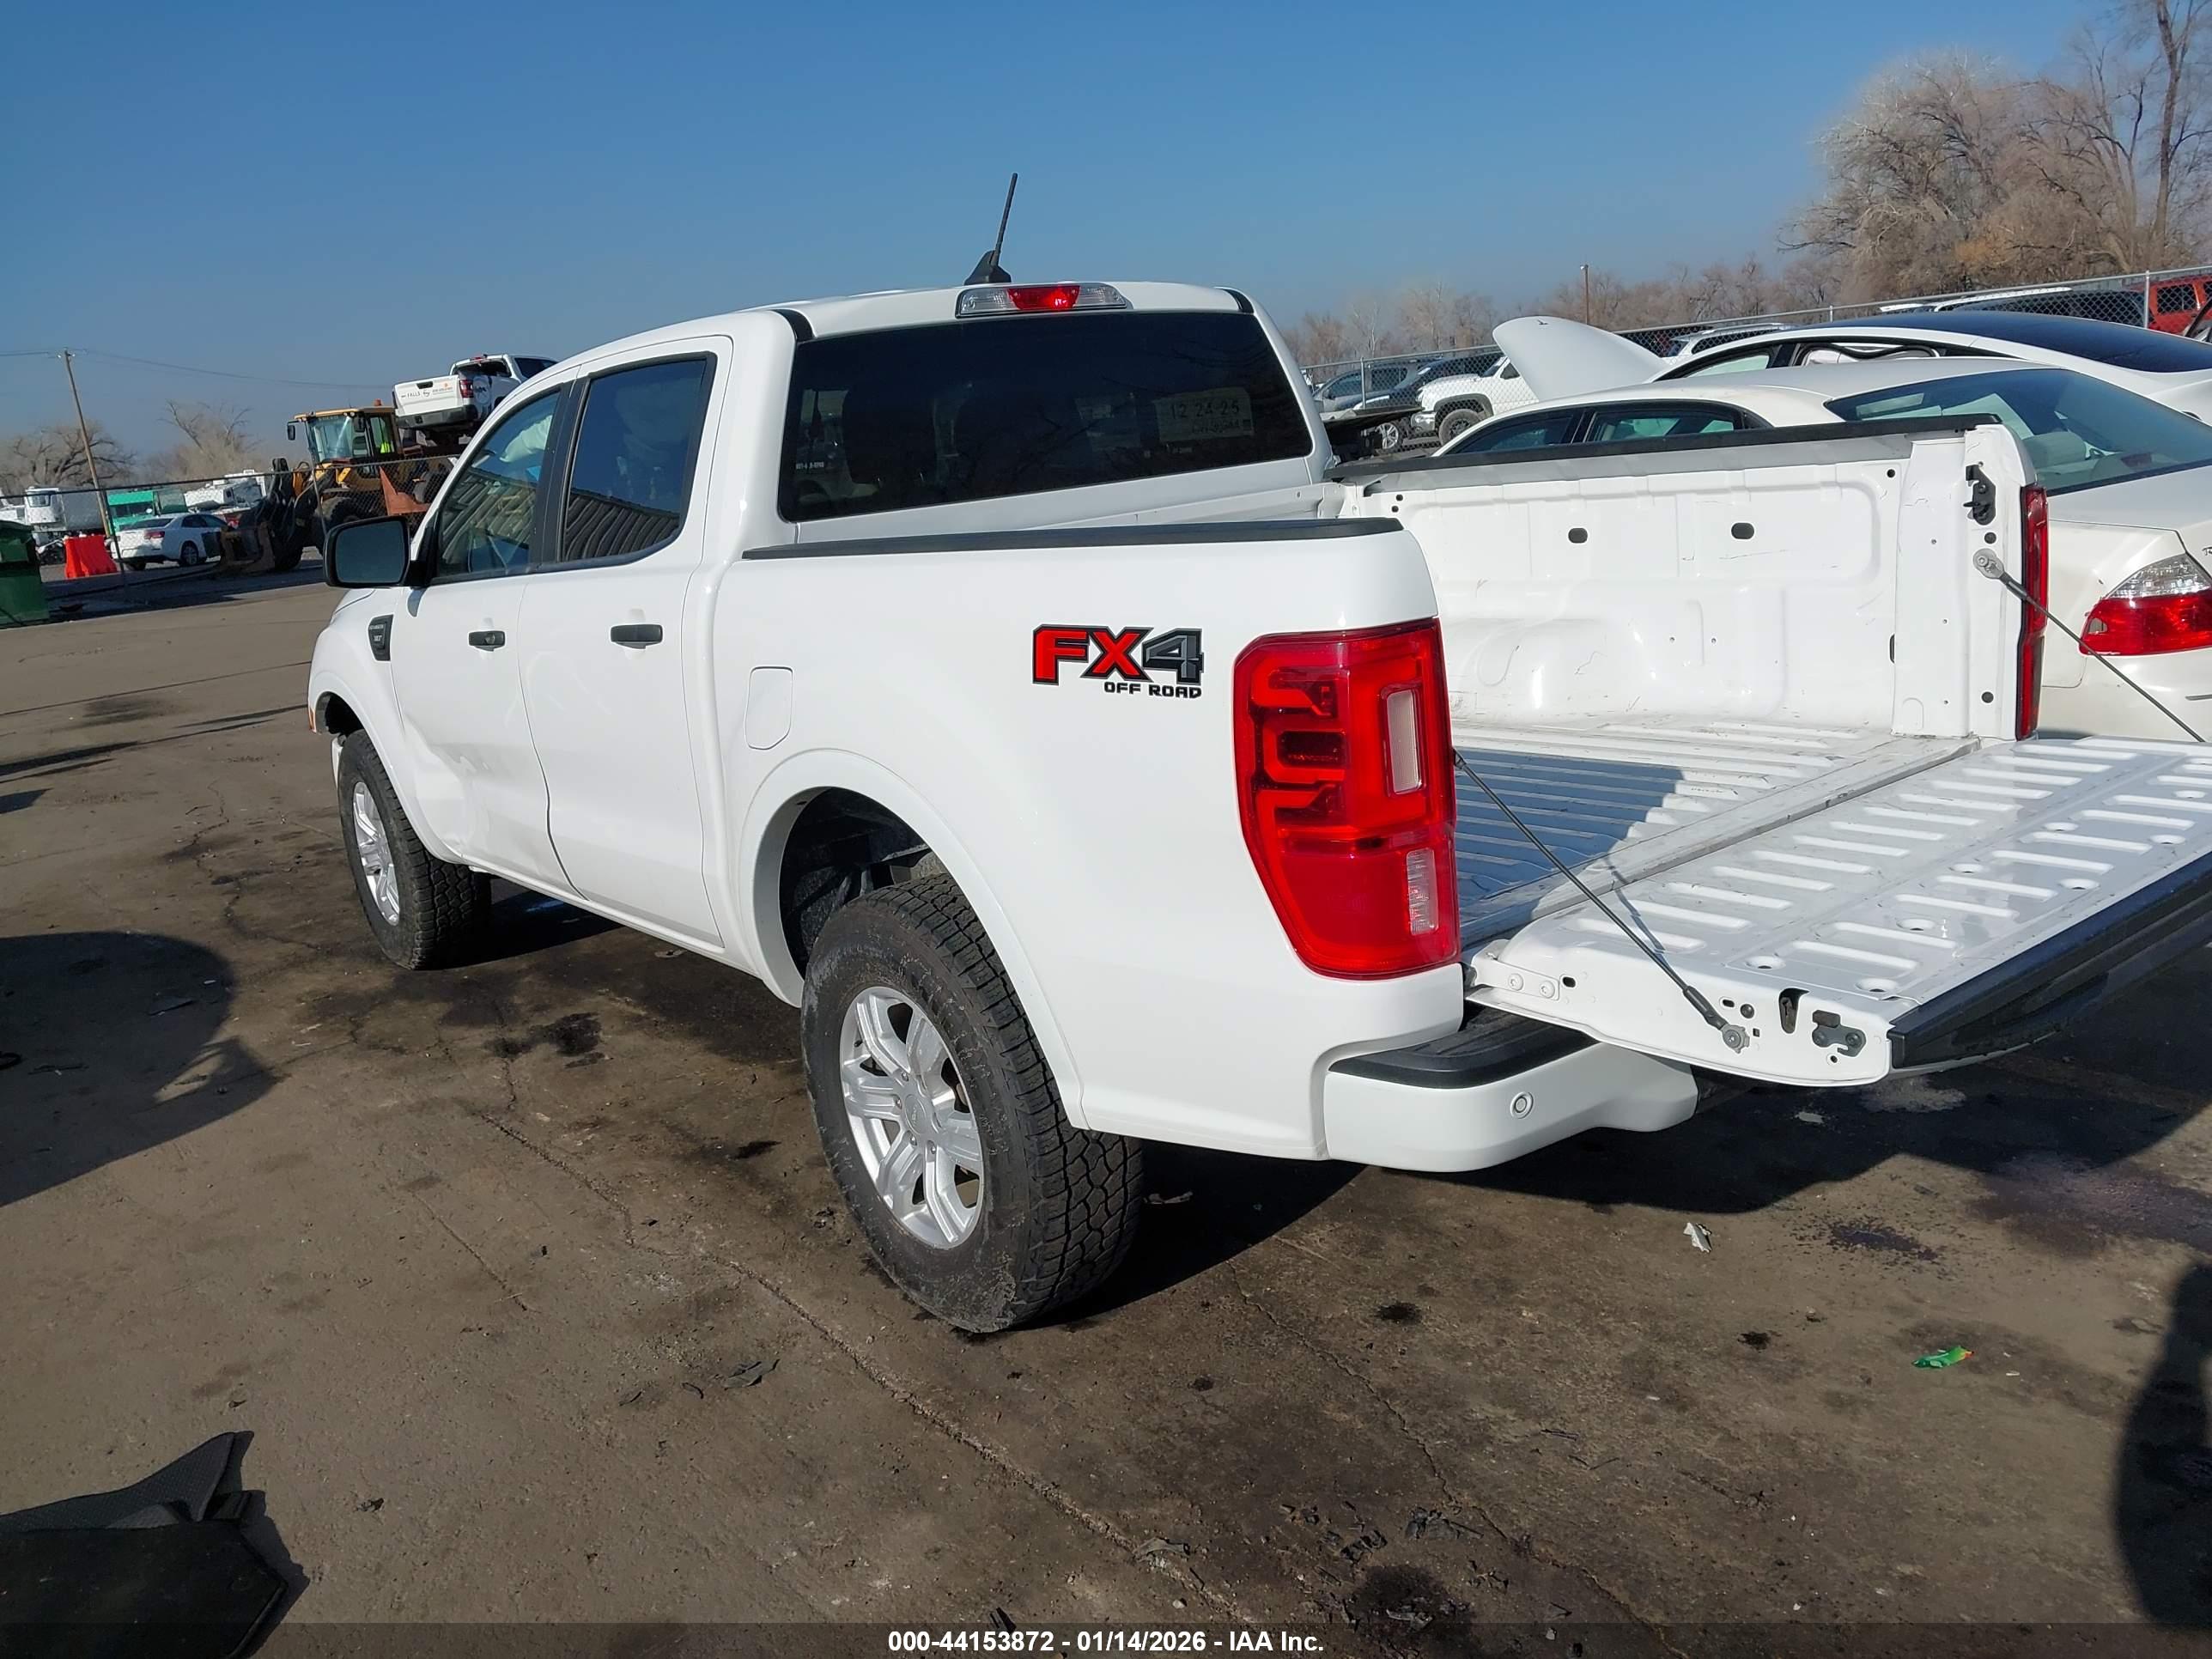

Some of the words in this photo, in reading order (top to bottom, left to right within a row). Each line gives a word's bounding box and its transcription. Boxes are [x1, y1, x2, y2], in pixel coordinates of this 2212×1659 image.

[1033, 623, 1204, 686] FX4
[1104, 681, 1141, 695] OFF
[1148, 684, 1202, 699] ROAD
